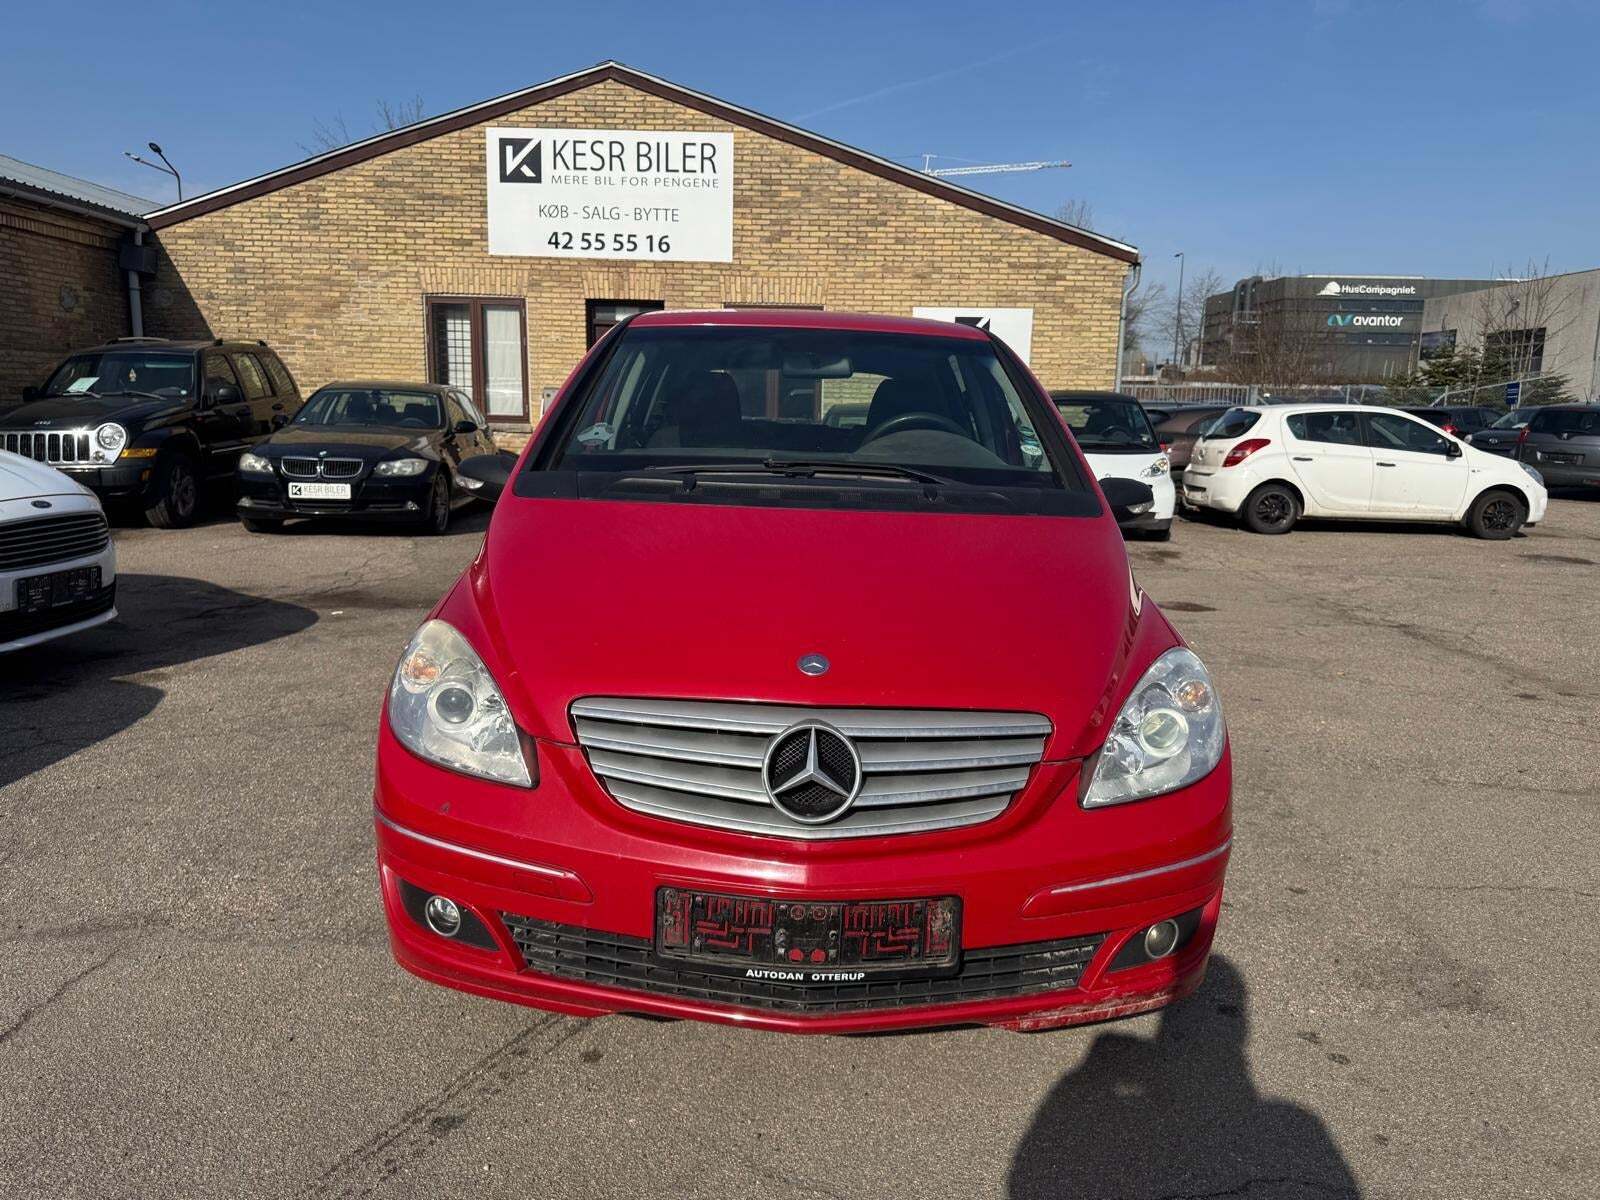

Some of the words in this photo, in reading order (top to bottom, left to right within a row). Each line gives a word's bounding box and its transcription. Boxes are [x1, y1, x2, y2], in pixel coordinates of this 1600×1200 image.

[553, 140, 626, 172] KESR
[637, 142, 718, 174] BILER
[551, 175, 589, 186] MERE
[595, 176, 616, 187] BIL
[622, 177, 648, 187] FOR
[654, 178, 720, 189] PENGENE
[538, 204, 569, 219] KØB
[582, 206, 621, 221] SALG
[634, 208, 680, 222] BYTTE
[547, 232, 574, 250] 42
[580, 233, 605, 251] 55
[613, 234, 638, 252] 55
[646, 235, 671, 253] 16
[1341, 284, 1416, 296] HusCompagniet
[1353, 315, 1403, 327] avantor
[745, 969, 804, 981] AUTODAN
[811, 972, 865, 981] OTTERUP
